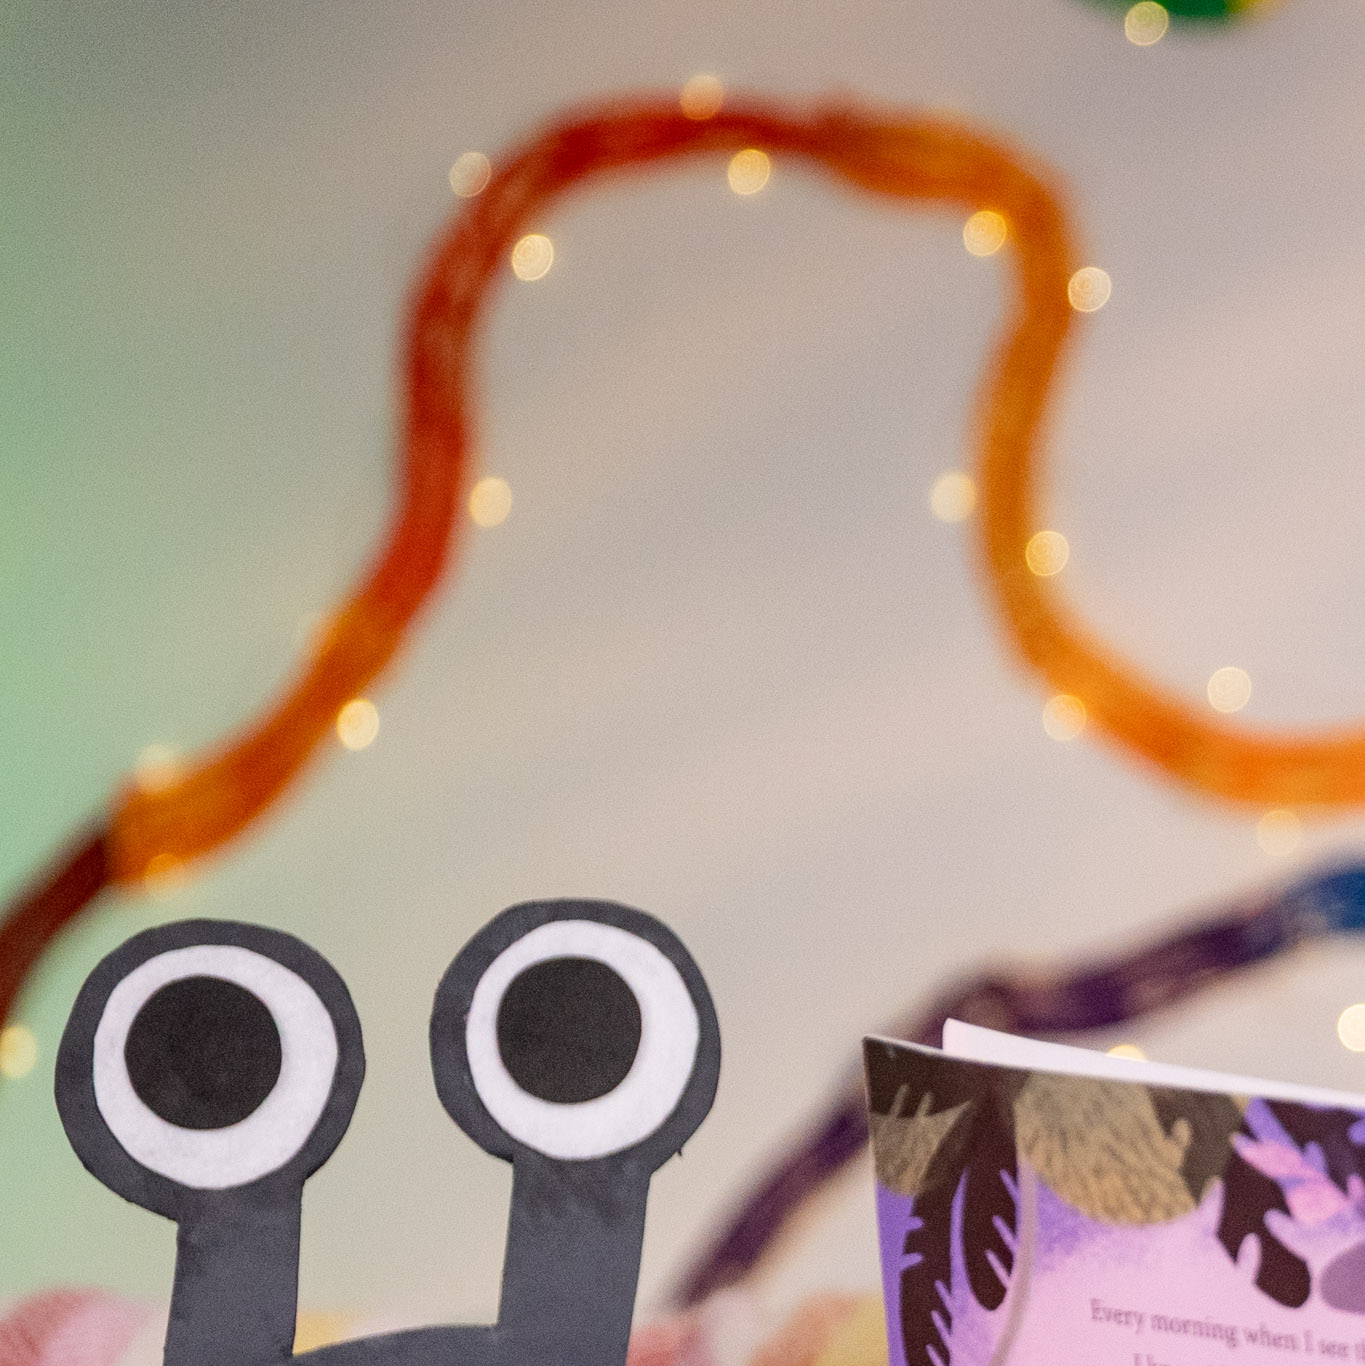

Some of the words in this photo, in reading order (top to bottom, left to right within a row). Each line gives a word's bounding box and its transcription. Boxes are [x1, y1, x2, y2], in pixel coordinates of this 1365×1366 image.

[1090, 1298, 1143, 1334] Every
[1150, 1314, 1239, 1350] morning
[1243, 1321, 1299, 1351] when
[1303, 1329, 1313, 1352] I
